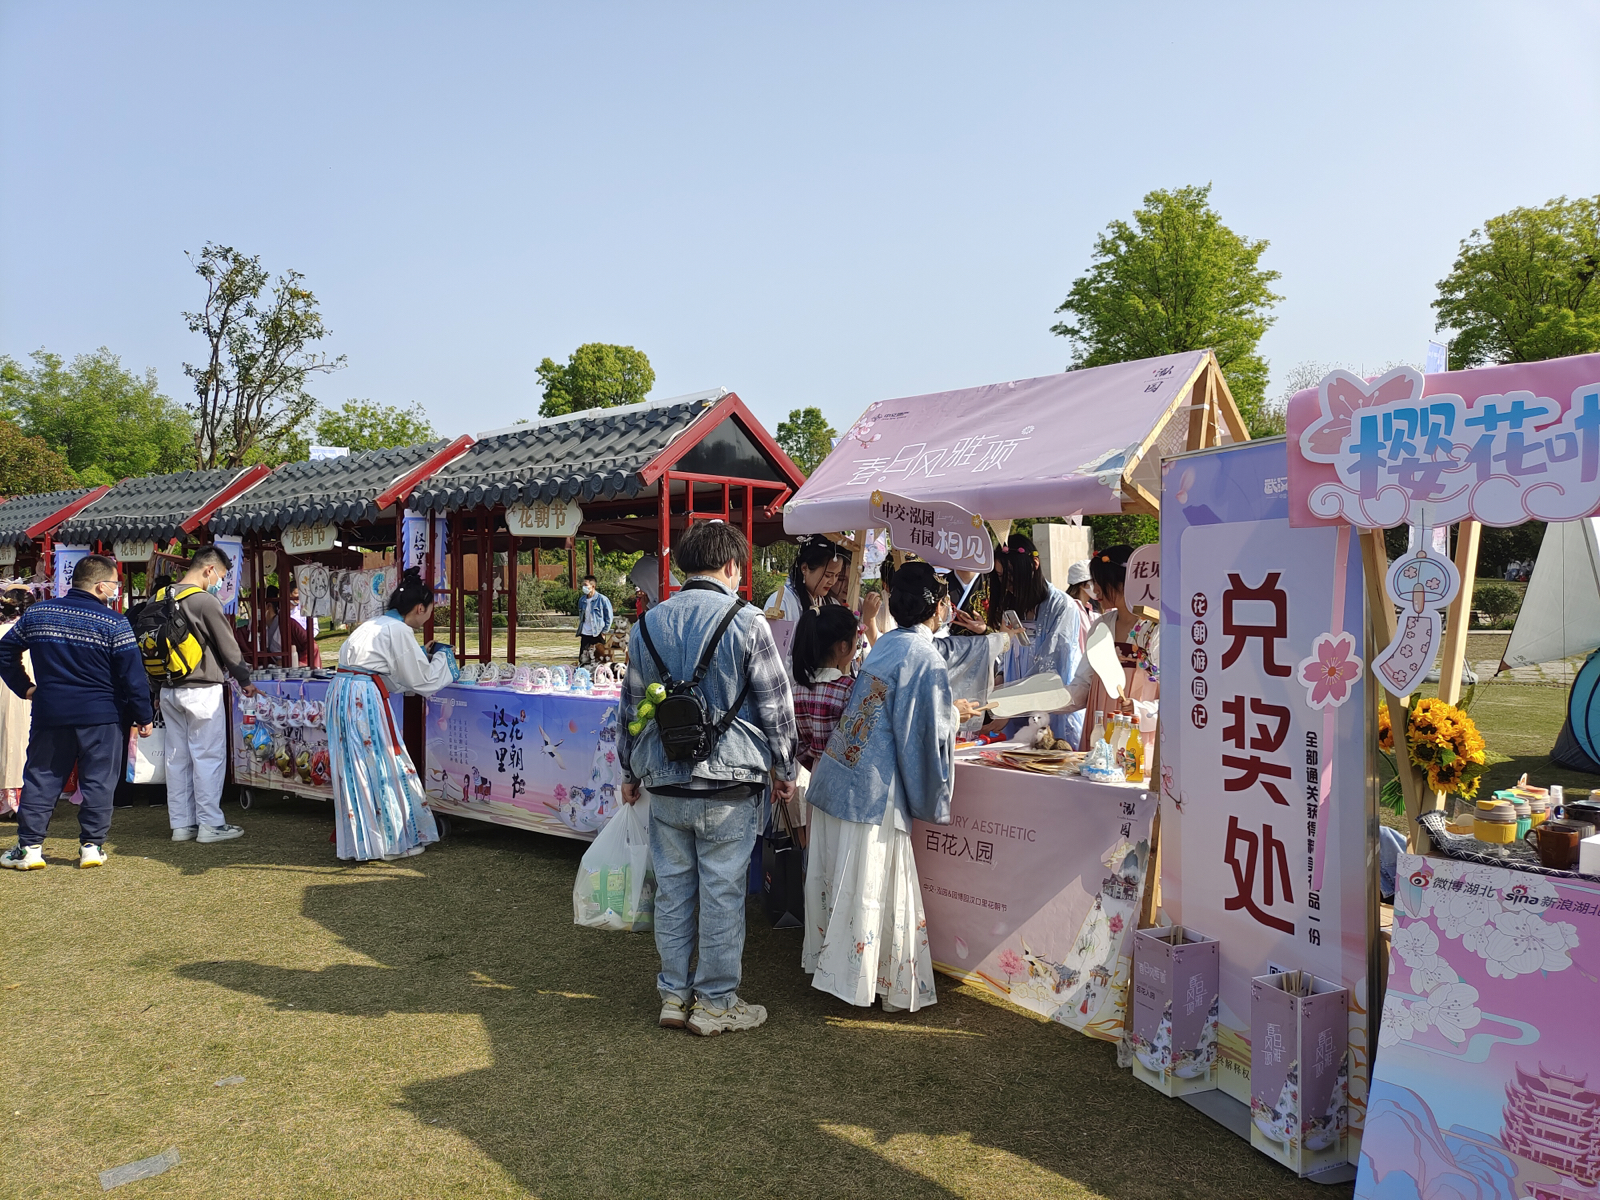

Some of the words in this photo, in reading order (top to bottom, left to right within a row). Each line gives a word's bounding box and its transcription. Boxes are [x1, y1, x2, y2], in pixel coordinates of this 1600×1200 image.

[846, 435, 1031, 485] 春日风雅颂
[517, 503, 568, 529] 花朝节
[882, 502, 935, 528] 中交·泓园
[290, 524, 326, 548] 花朝节
[1192, 594, 1207, 729] 花朝游园记
[491, 704, 509, 773] 汉口里
[1221, 572, 1295, 936] 兑奖处
[971, 819, 1037, 843] AESTHETIC
[1306, 731, 1320, 946] 全部通关获得精品一份
[925, 829, 994, 865] 百花入园
[1433, 877, 1496, 899] 微博湖北
[1505, 892, 1540, 906] sina
[1540, 896, 1600, 916] 新浪湖北
